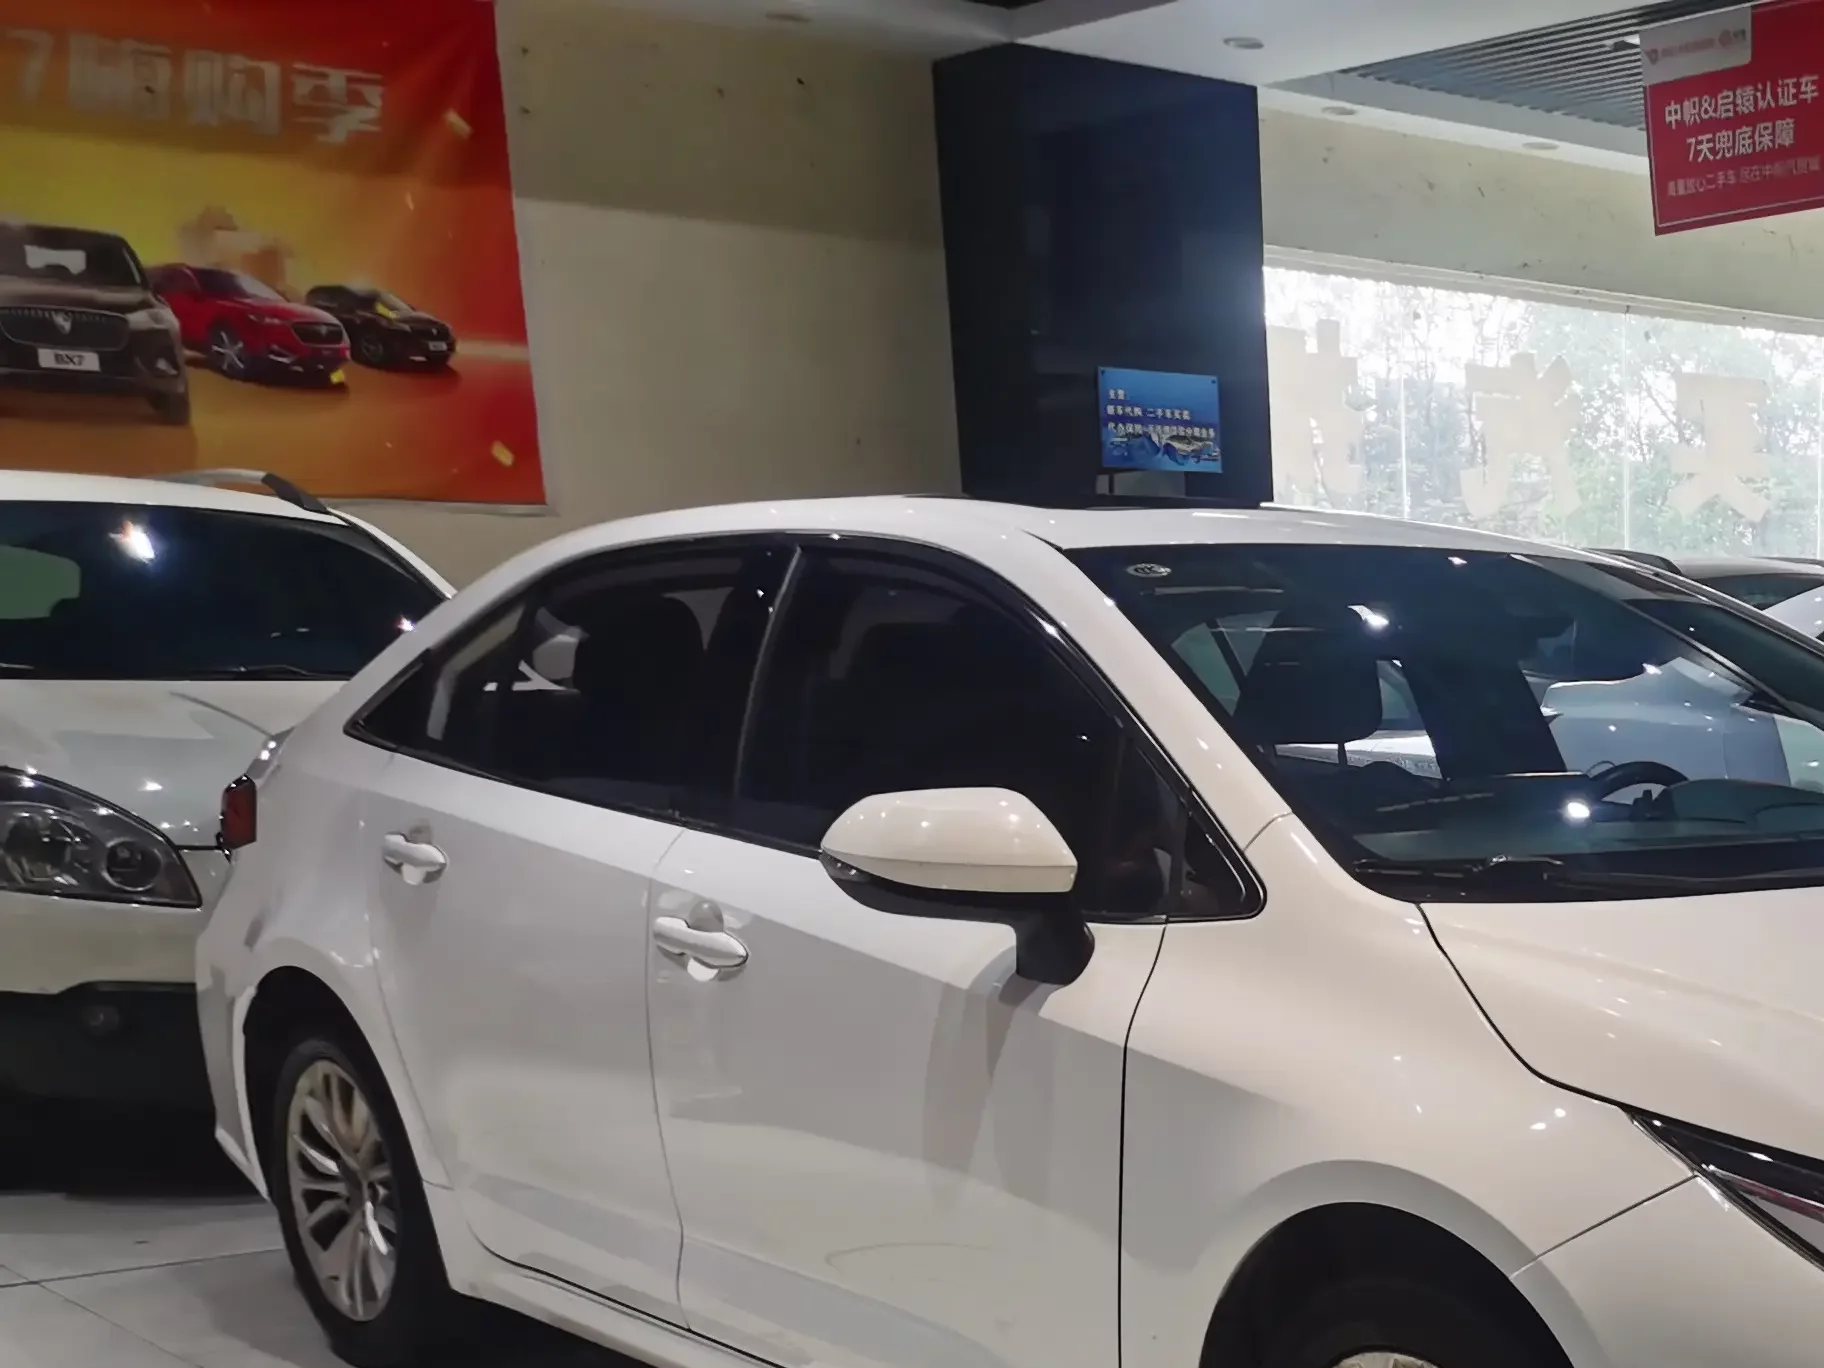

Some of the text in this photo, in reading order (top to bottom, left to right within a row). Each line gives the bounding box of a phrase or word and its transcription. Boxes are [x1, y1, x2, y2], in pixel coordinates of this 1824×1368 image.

[1686, 118, 1796, 162] 7天兜底保障
